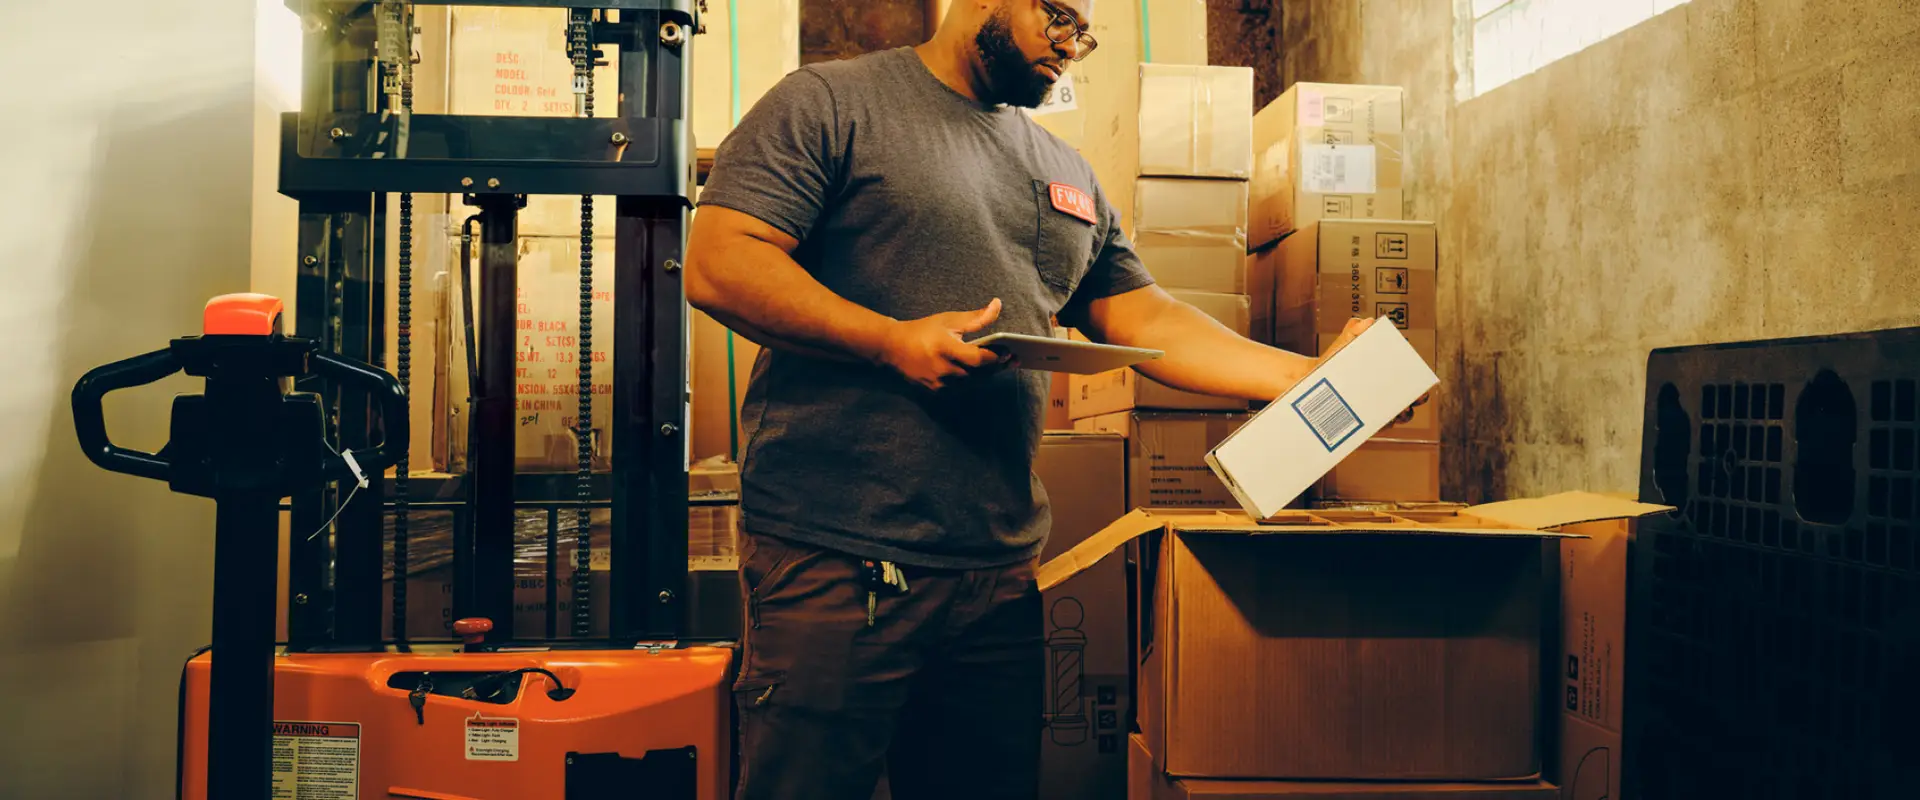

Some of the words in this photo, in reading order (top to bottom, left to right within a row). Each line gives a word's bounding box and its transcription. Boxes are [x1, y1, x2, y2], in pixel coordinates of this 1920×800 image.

[538, 320, 567, 332] BLACK
[547, 368, 558, 379] 12
[533, 400, 562, 411] CHINA
[272, 723, 329, 735] WARNING
